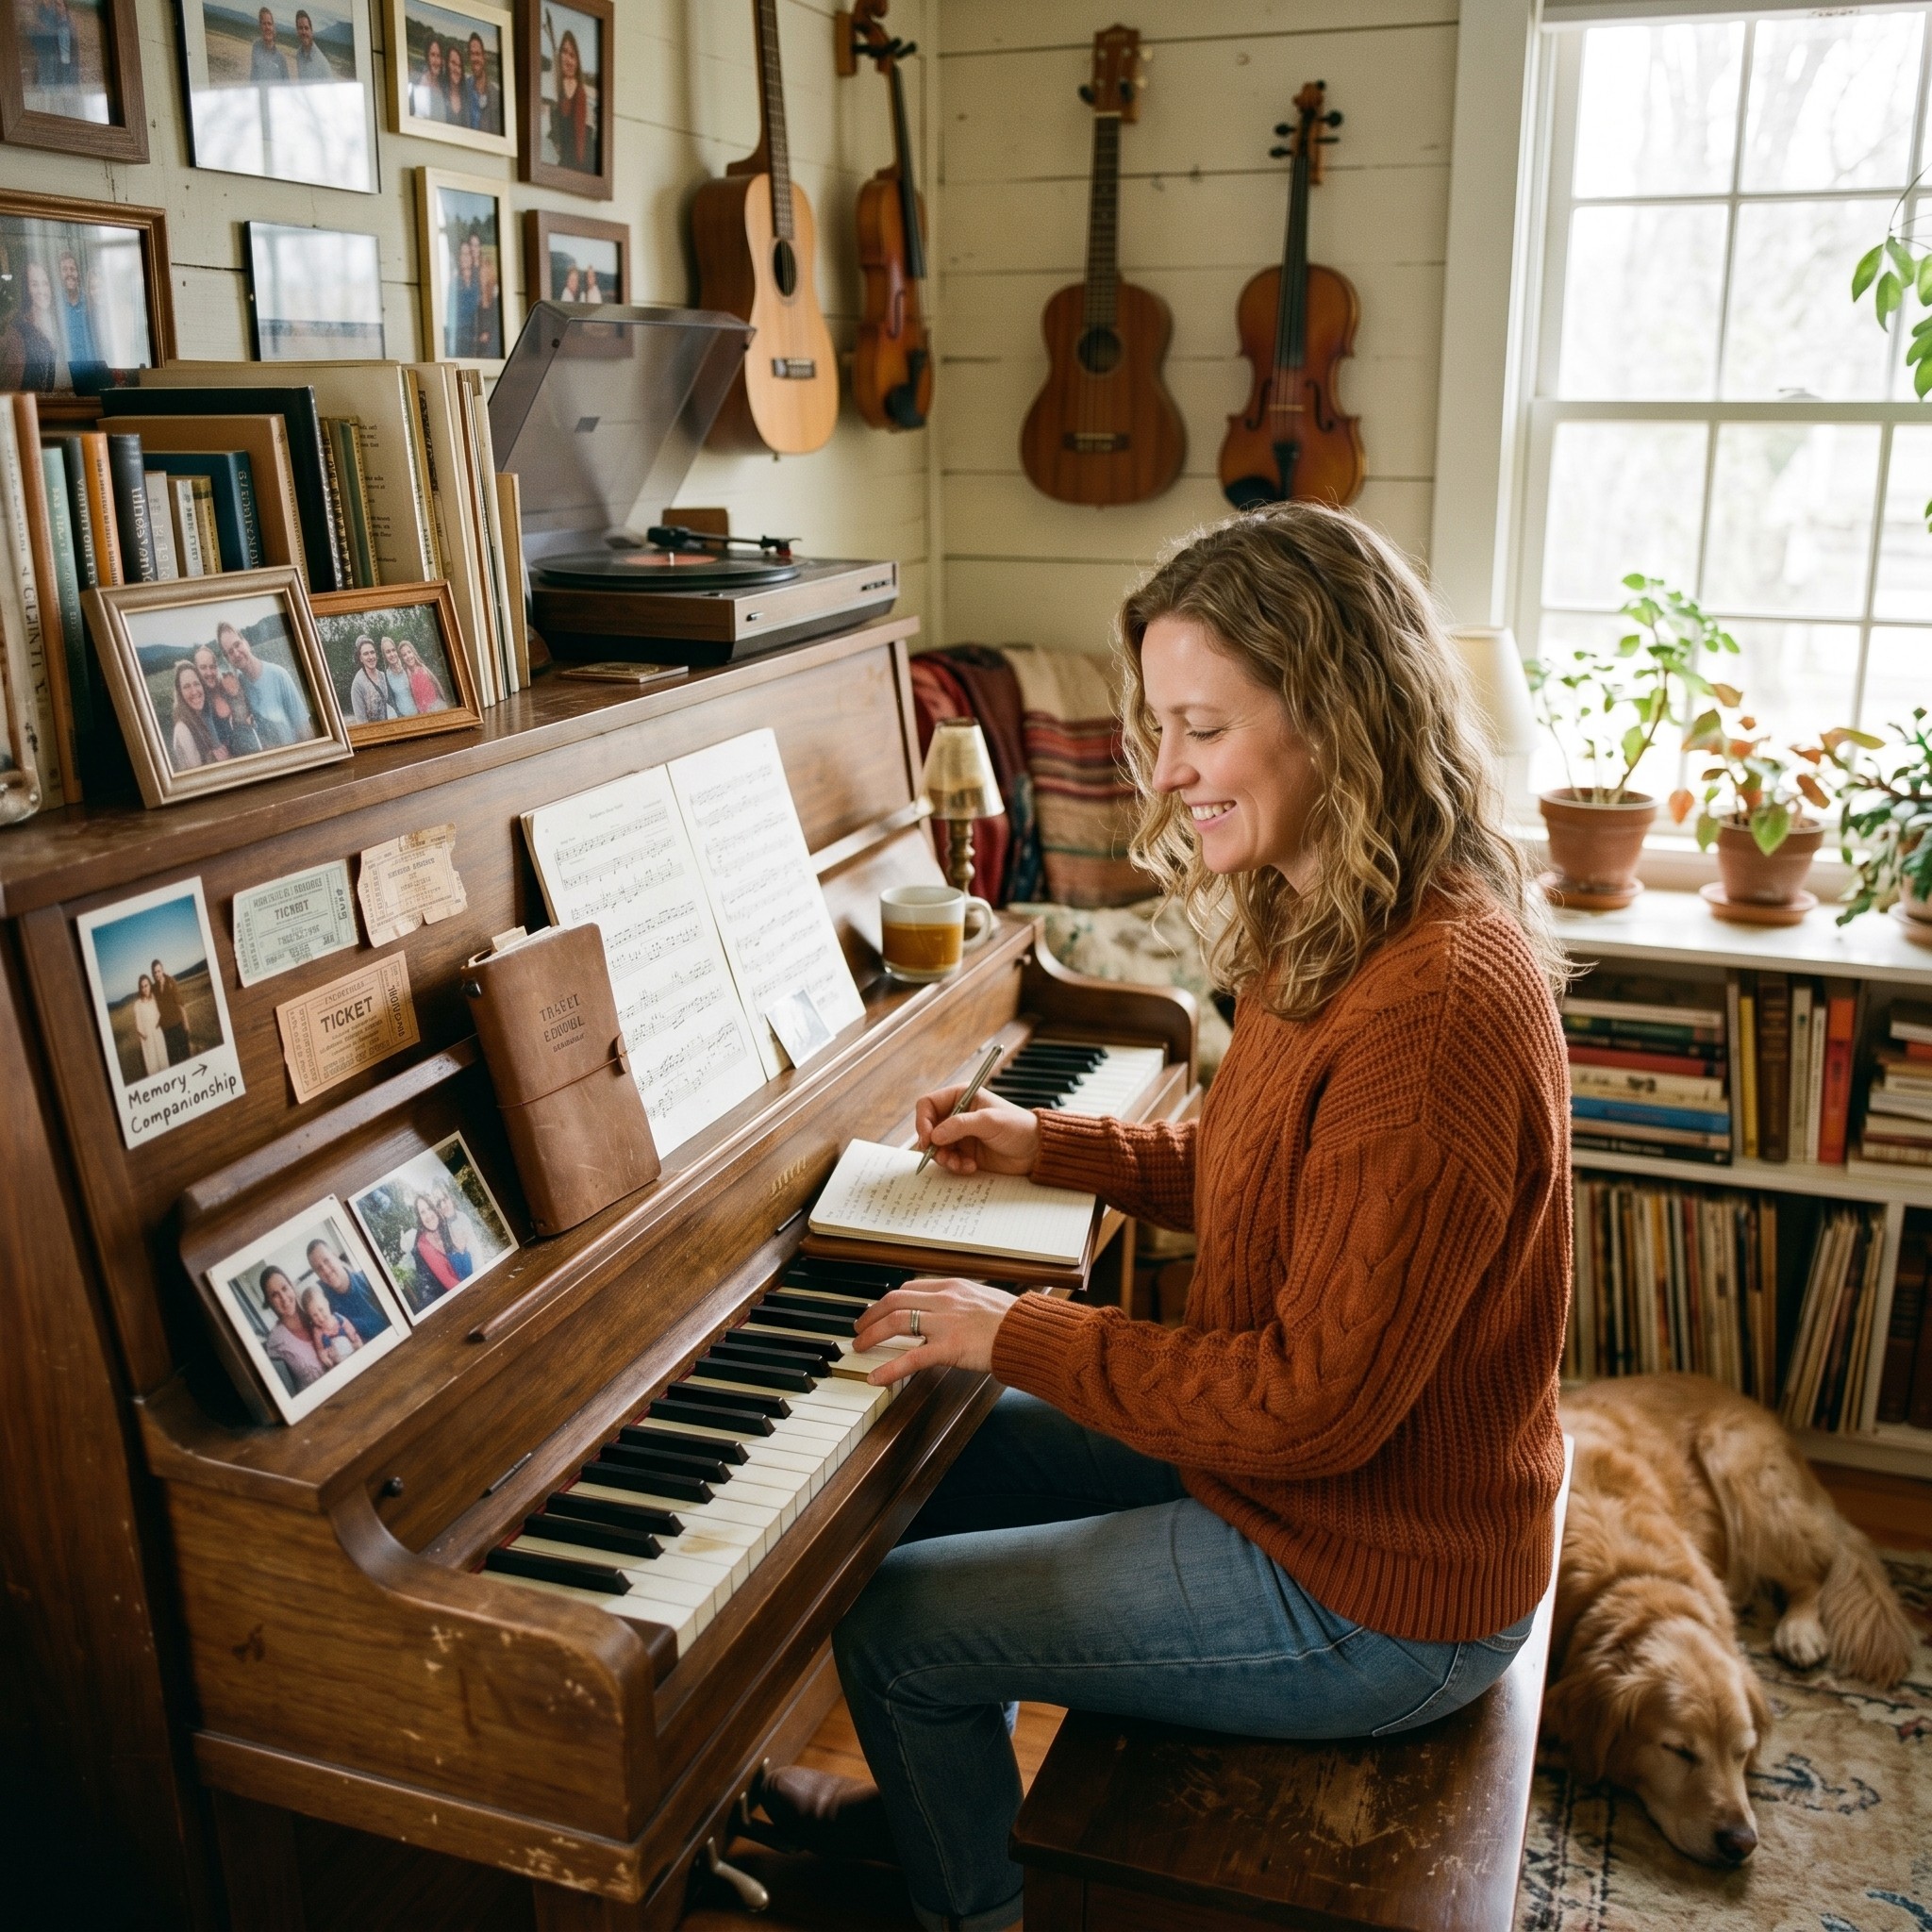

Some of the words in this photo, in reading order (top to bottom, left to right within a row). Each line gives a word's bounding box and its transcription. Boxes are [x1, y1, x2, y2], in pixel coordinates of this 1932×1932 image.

[321, 995, 373, 1033] TICKET
[128, 1074, 187, 1109] Memory
[131, 1073, 237, 1134] Companionship
